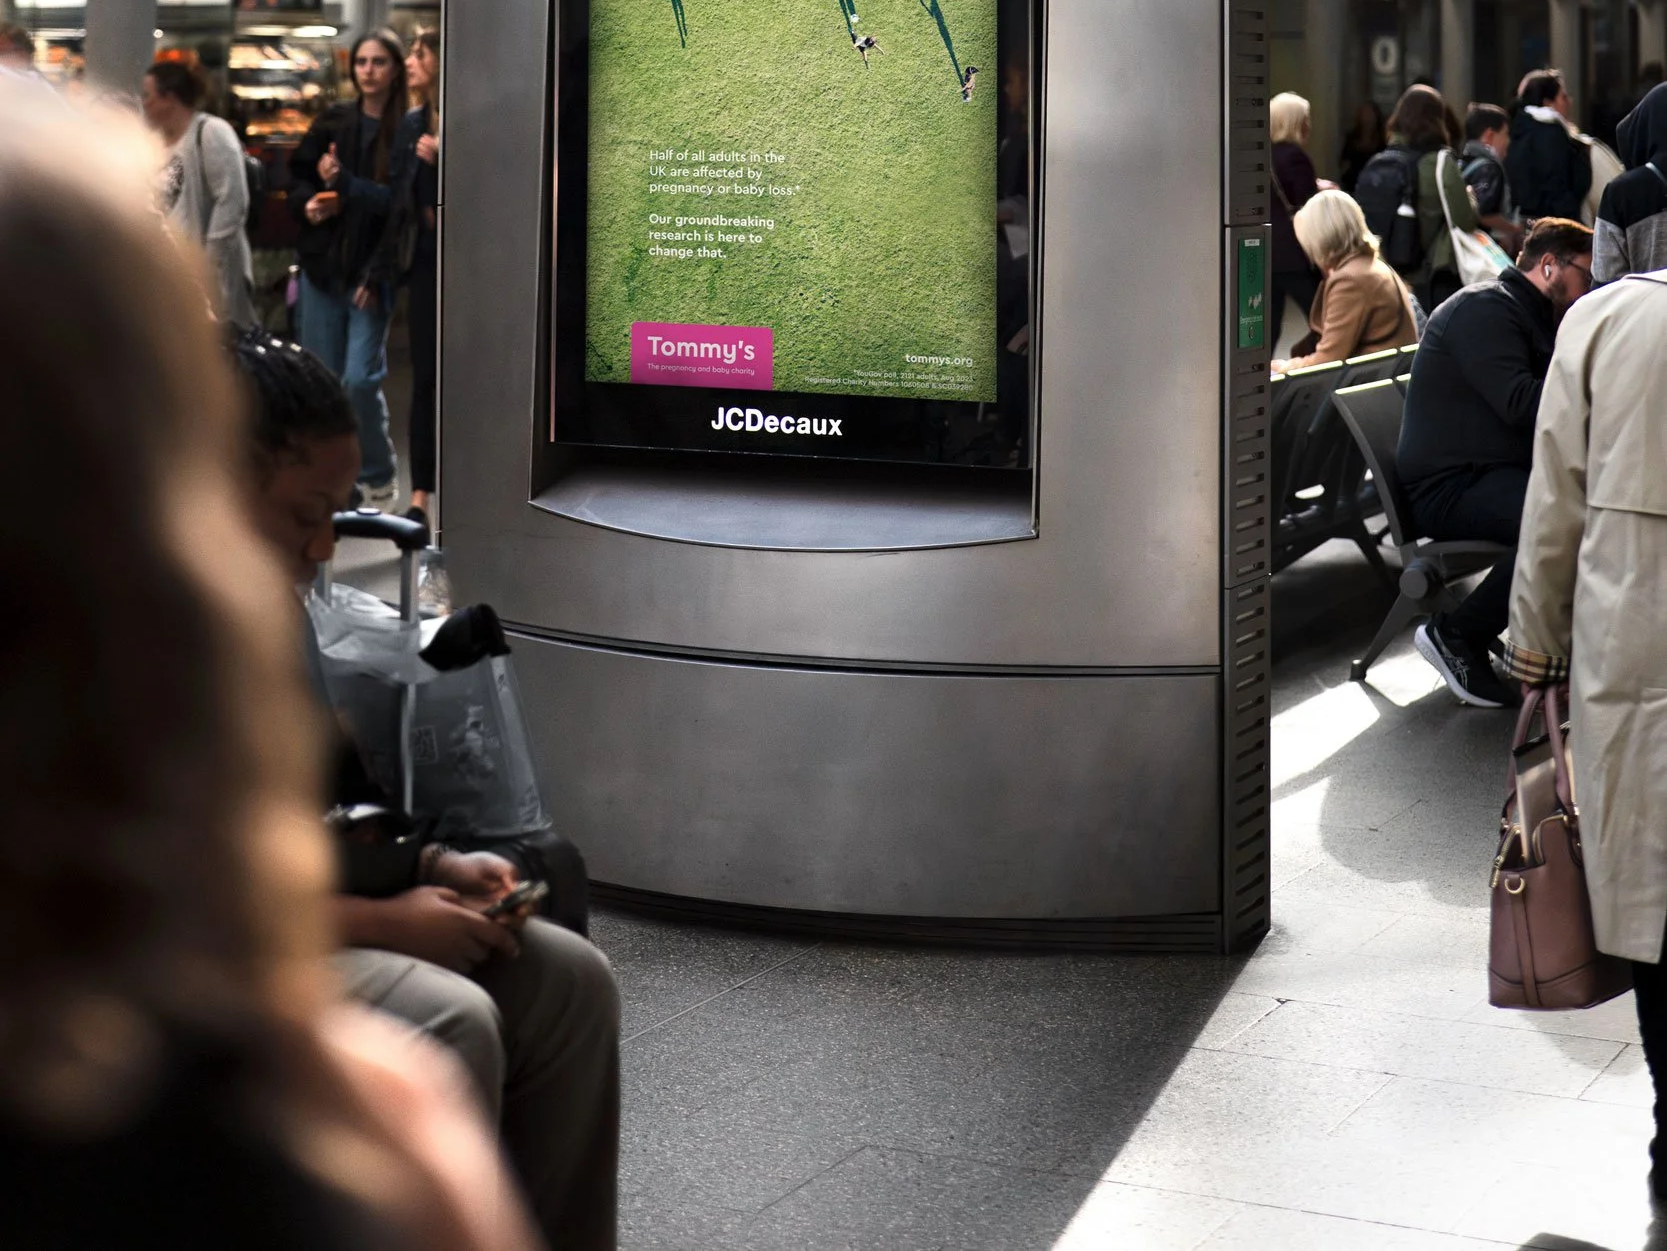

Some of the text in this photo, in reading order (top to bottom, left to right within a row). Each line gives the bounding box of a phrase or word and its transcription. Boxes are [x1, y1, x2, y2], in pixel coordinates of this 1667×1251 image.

[650, 150, 785, 163] Half of all adults in the
[649, 166, 762, 181] UK are affected by
[649, 183, 714, 195] pregnancy
[734, 184, 765, 197] baby
[649, 214, 775, 229] Our groundbreaking
[649, 230, 763, 243] research is here to
[649, 245, 726, 259] change that.
[647, 336, 755, 364] Tommy's
[905, 353, 973, 367] tommys.org
[711, 406, 843, 436] JCDecaux
